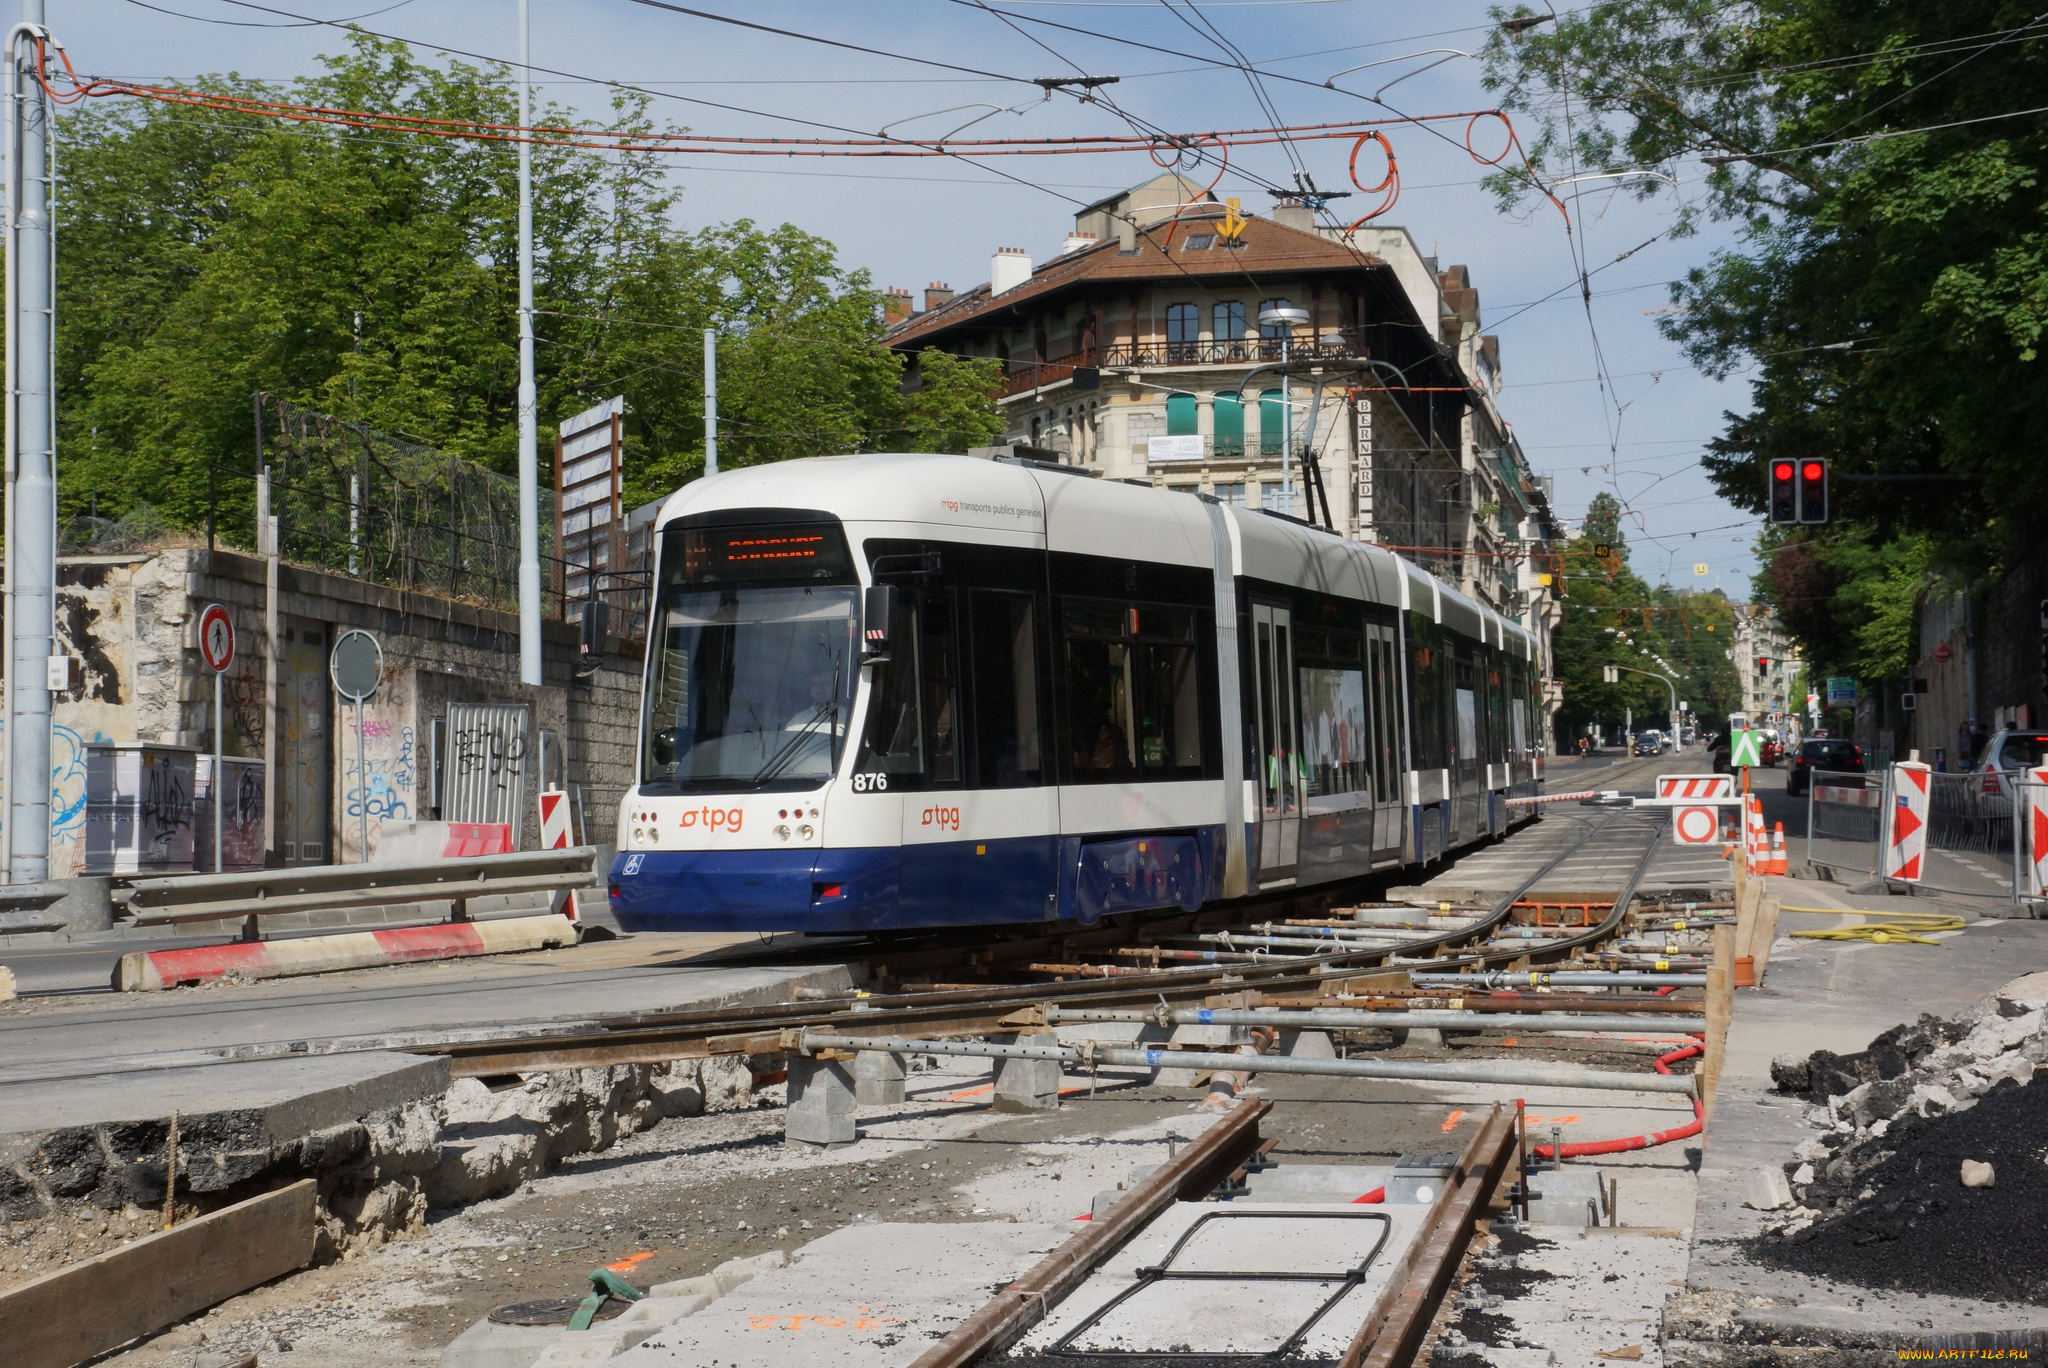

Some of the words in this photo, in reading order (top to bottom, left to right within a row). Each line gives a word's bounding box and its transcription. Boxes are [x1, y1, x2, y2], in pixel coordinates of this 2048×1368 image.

[1359, 400, 1371, 495] BERNARD
[960, 501, 992, 514] transports
[993, 504, 1016, 516] publics
[1016, 507, 1042, 519] genevois
[1597, 546, 1608, 556] 40
[854, 773, 888, 792] 876
